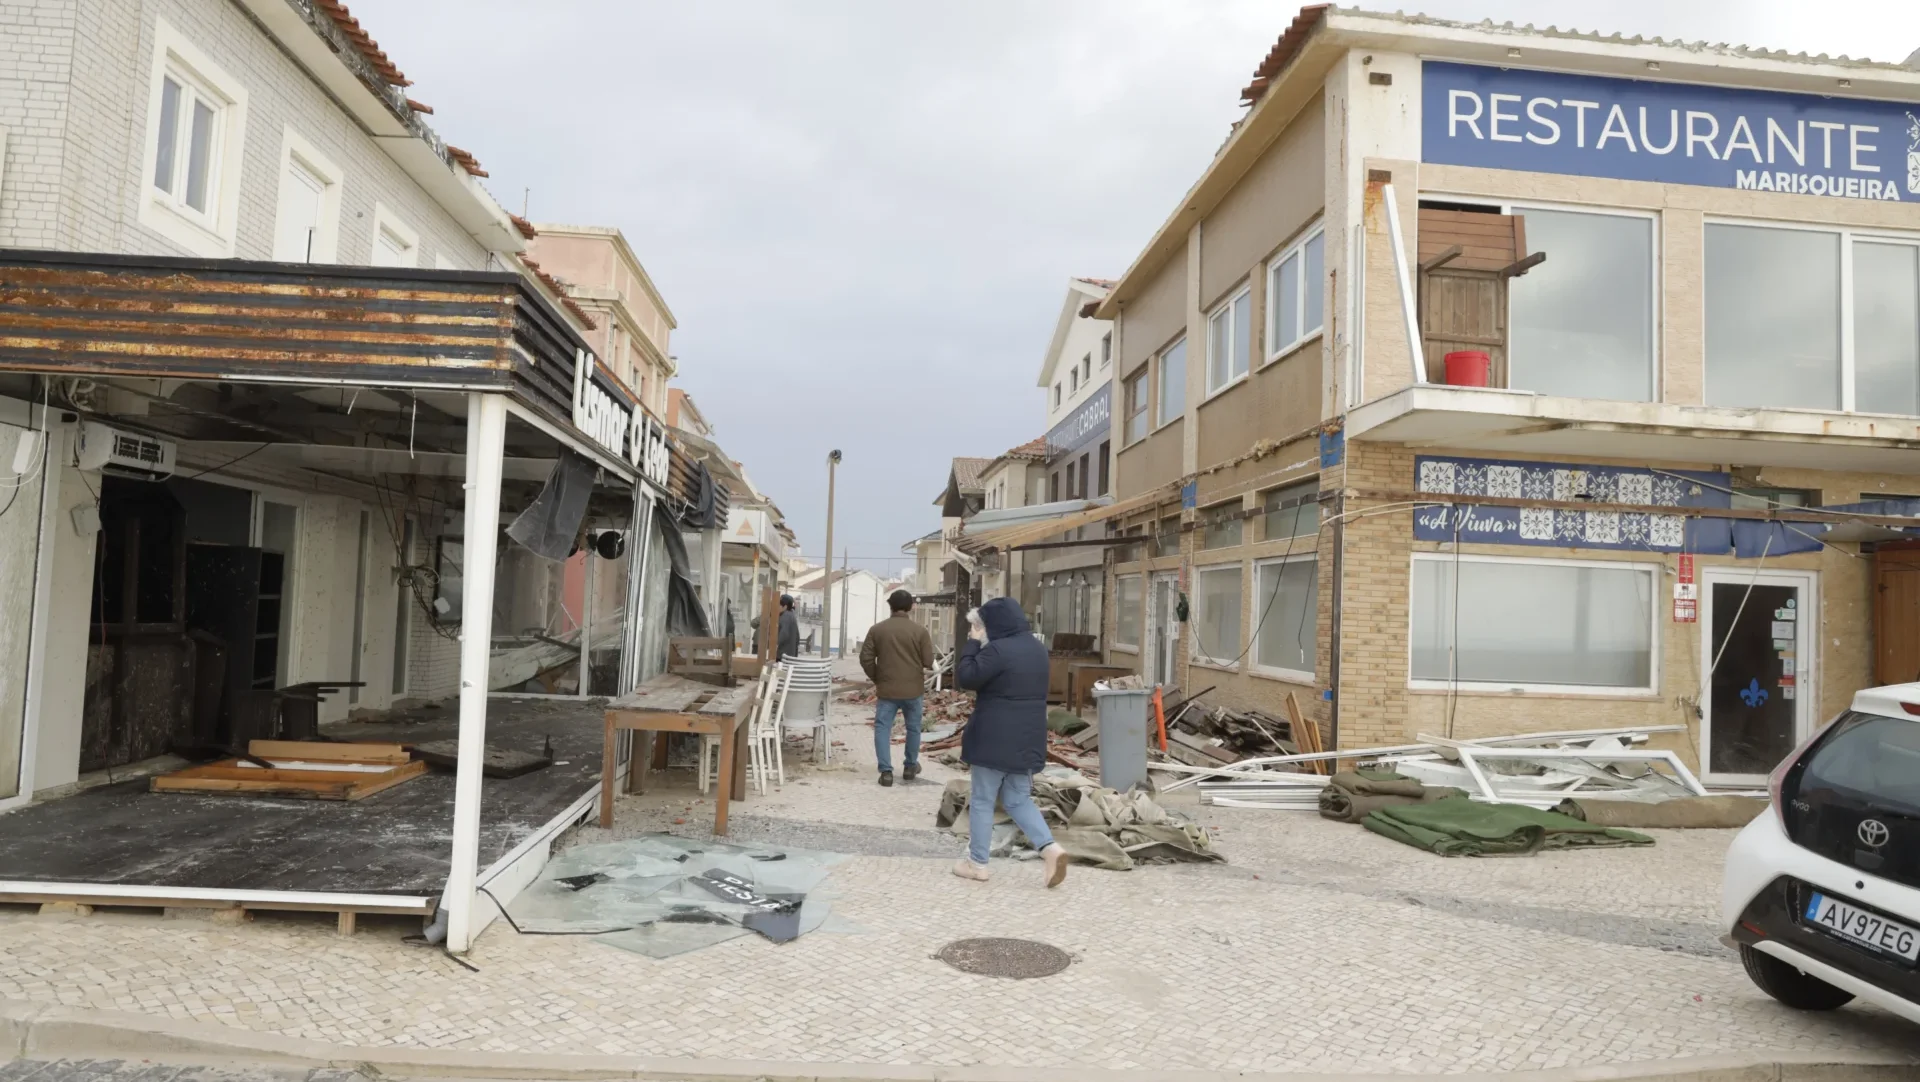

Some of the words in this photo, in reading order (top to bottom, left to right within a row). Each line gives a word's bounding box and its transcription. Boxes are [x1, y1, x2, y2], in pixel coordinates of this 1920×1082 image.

[1447, 89, 1881, 173] RESTAURANTE
[1736, 169, 1900, 201] MARISQUEIRA
[573, 347, 628, 458] Lismar
[630, 403, 643, 468] O
[1079, 393, 1110, 436] CABRAL
[1821, 903, 1914, 954] AV97EG
